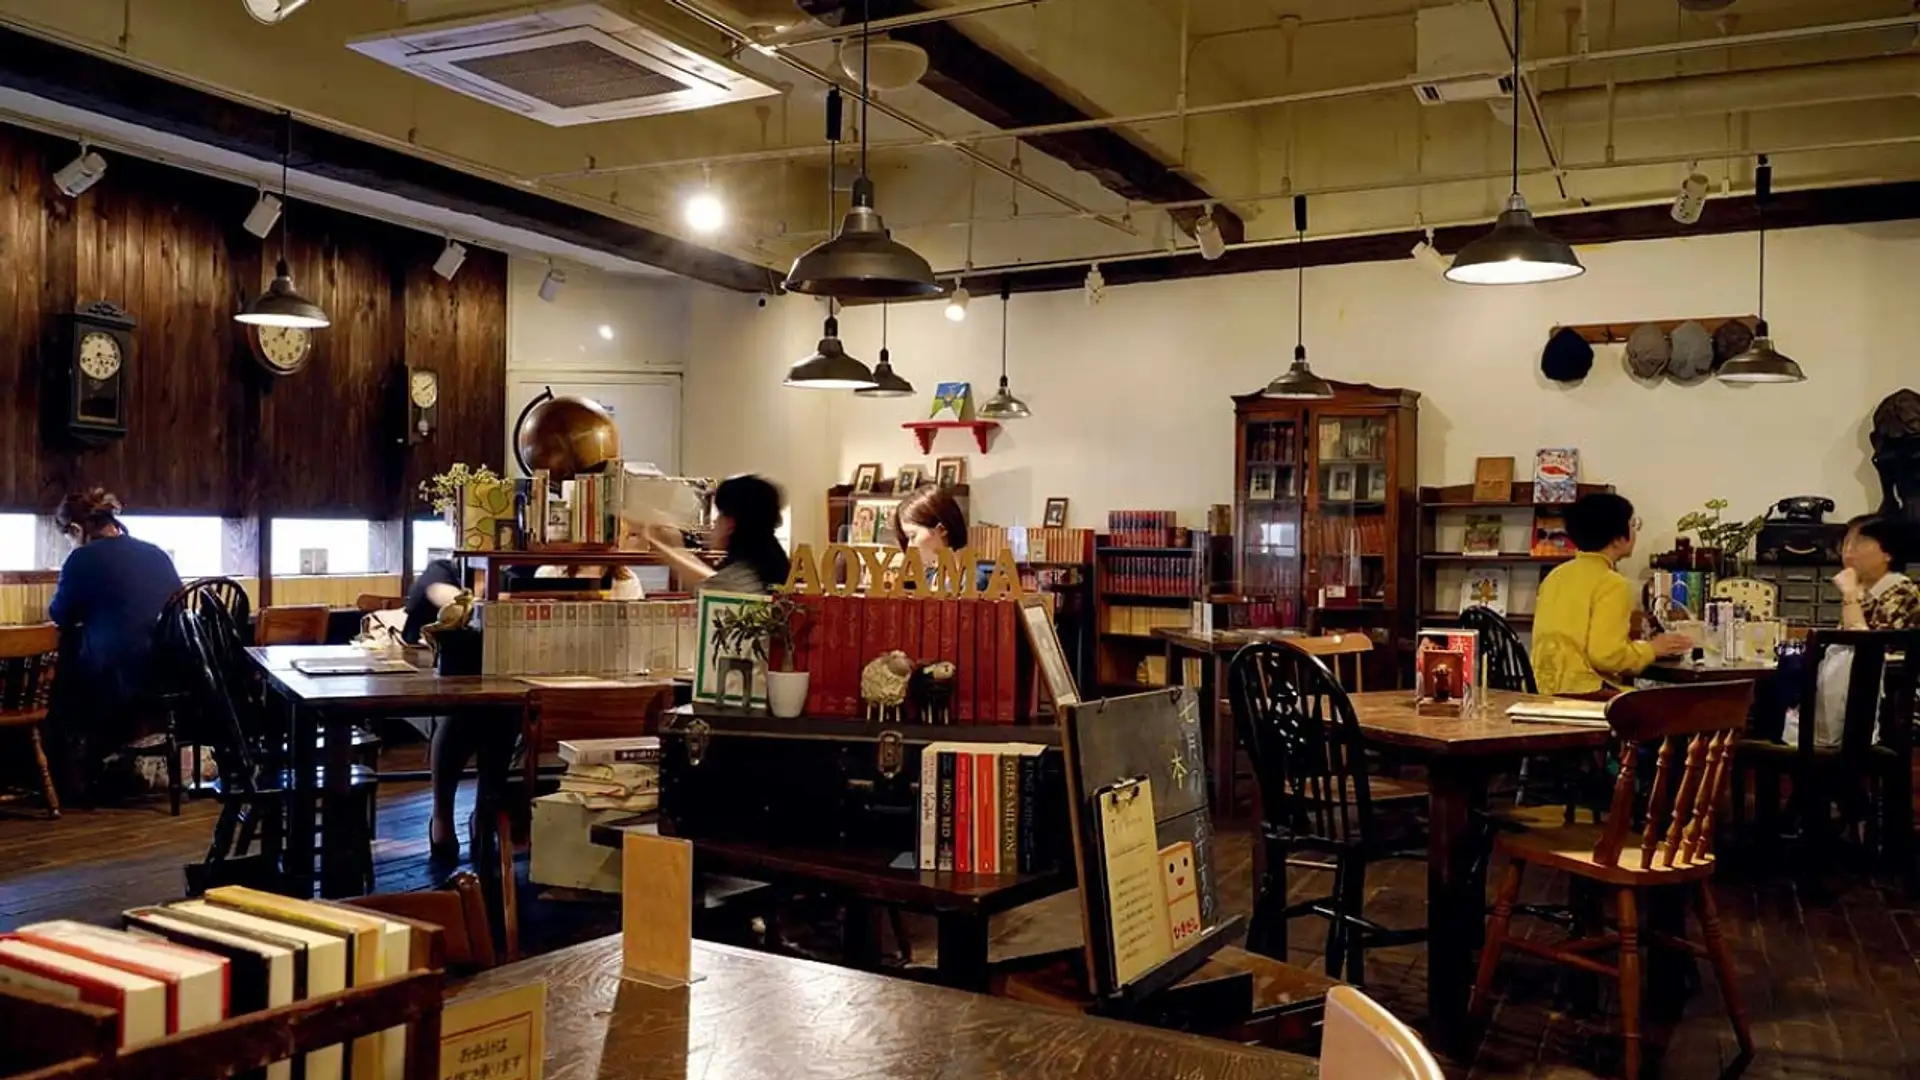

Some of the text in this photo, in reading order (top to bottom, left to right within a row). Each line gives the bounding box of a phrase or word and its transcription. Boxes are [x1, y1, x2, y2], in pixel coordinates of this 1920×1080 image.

[786, 543, 1024, 600] AOYAMA
[1172, 747, 1188, 790] 本
[1004, 761, 1016, 851] GILES MILTON
